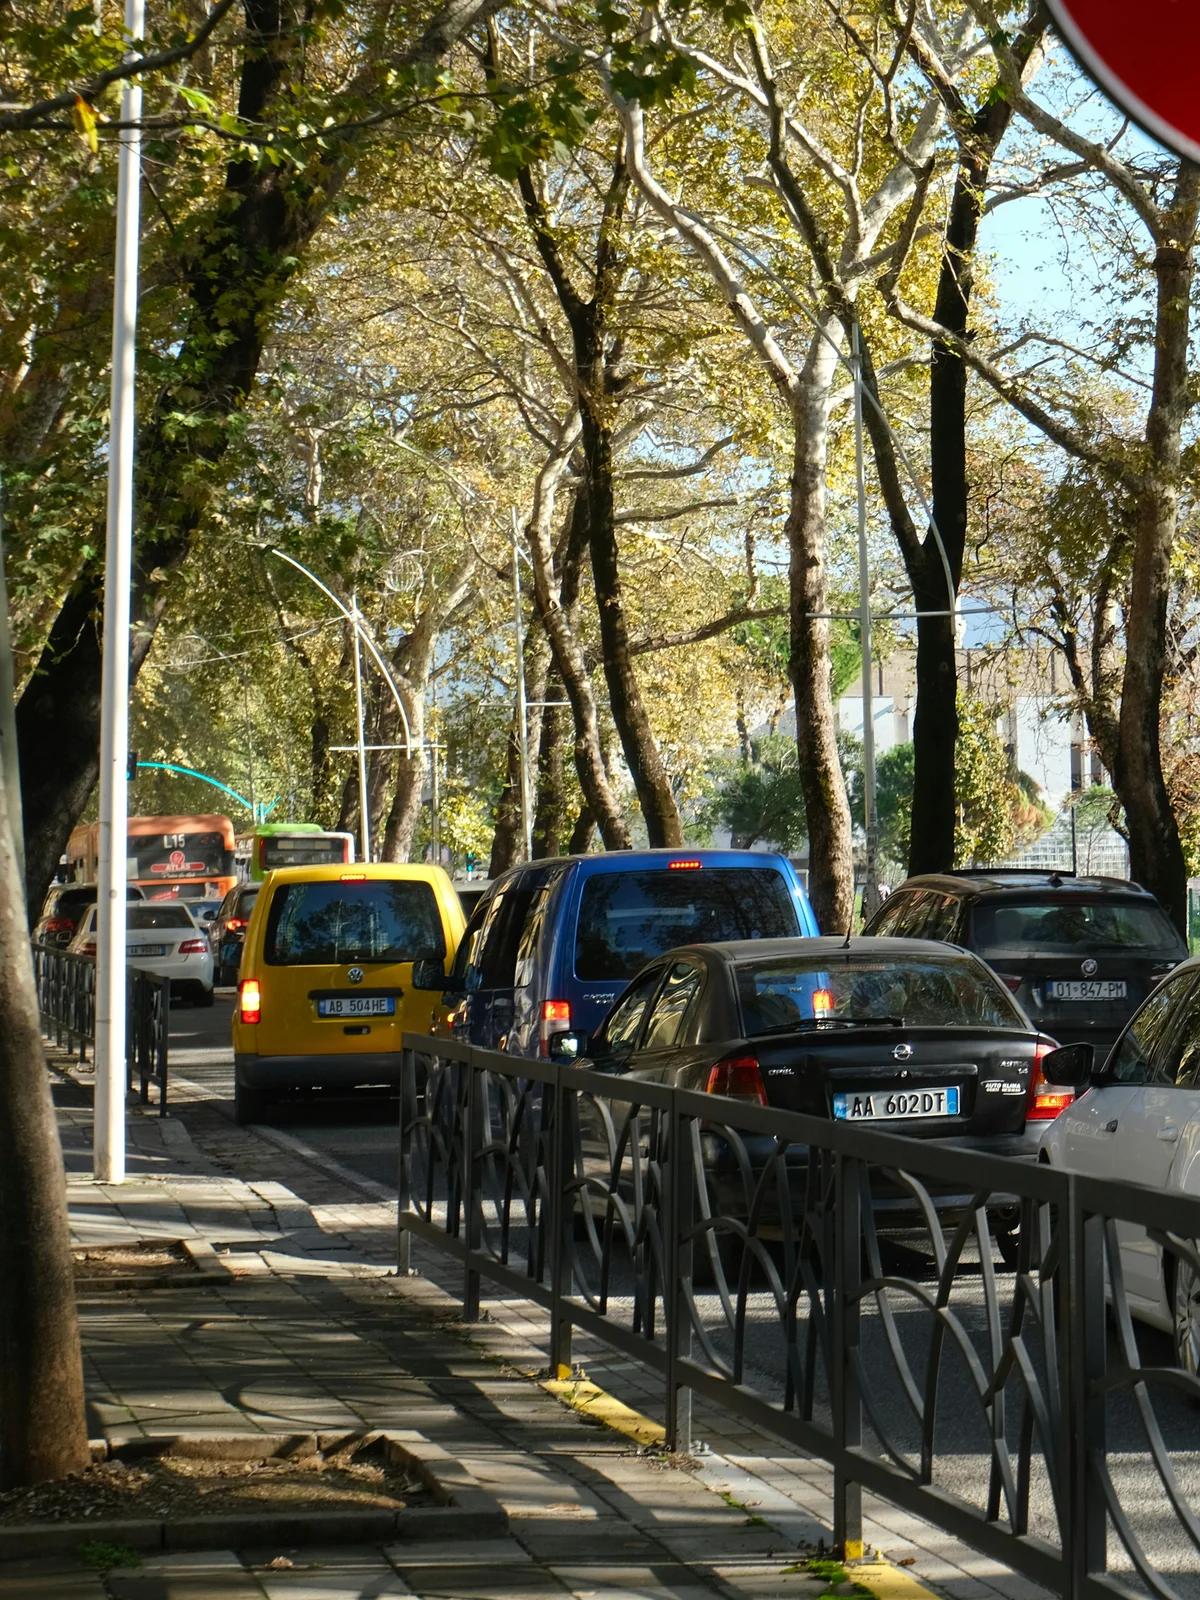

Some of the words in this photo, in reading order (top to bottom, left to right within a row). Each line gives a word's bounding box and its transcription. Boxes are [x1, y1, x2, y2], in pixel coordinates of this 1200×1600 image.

[163, 834, 185, 849] L15
[329, 1000, 343, 1012] AB
[851, 1096, 875, 1117] AA
